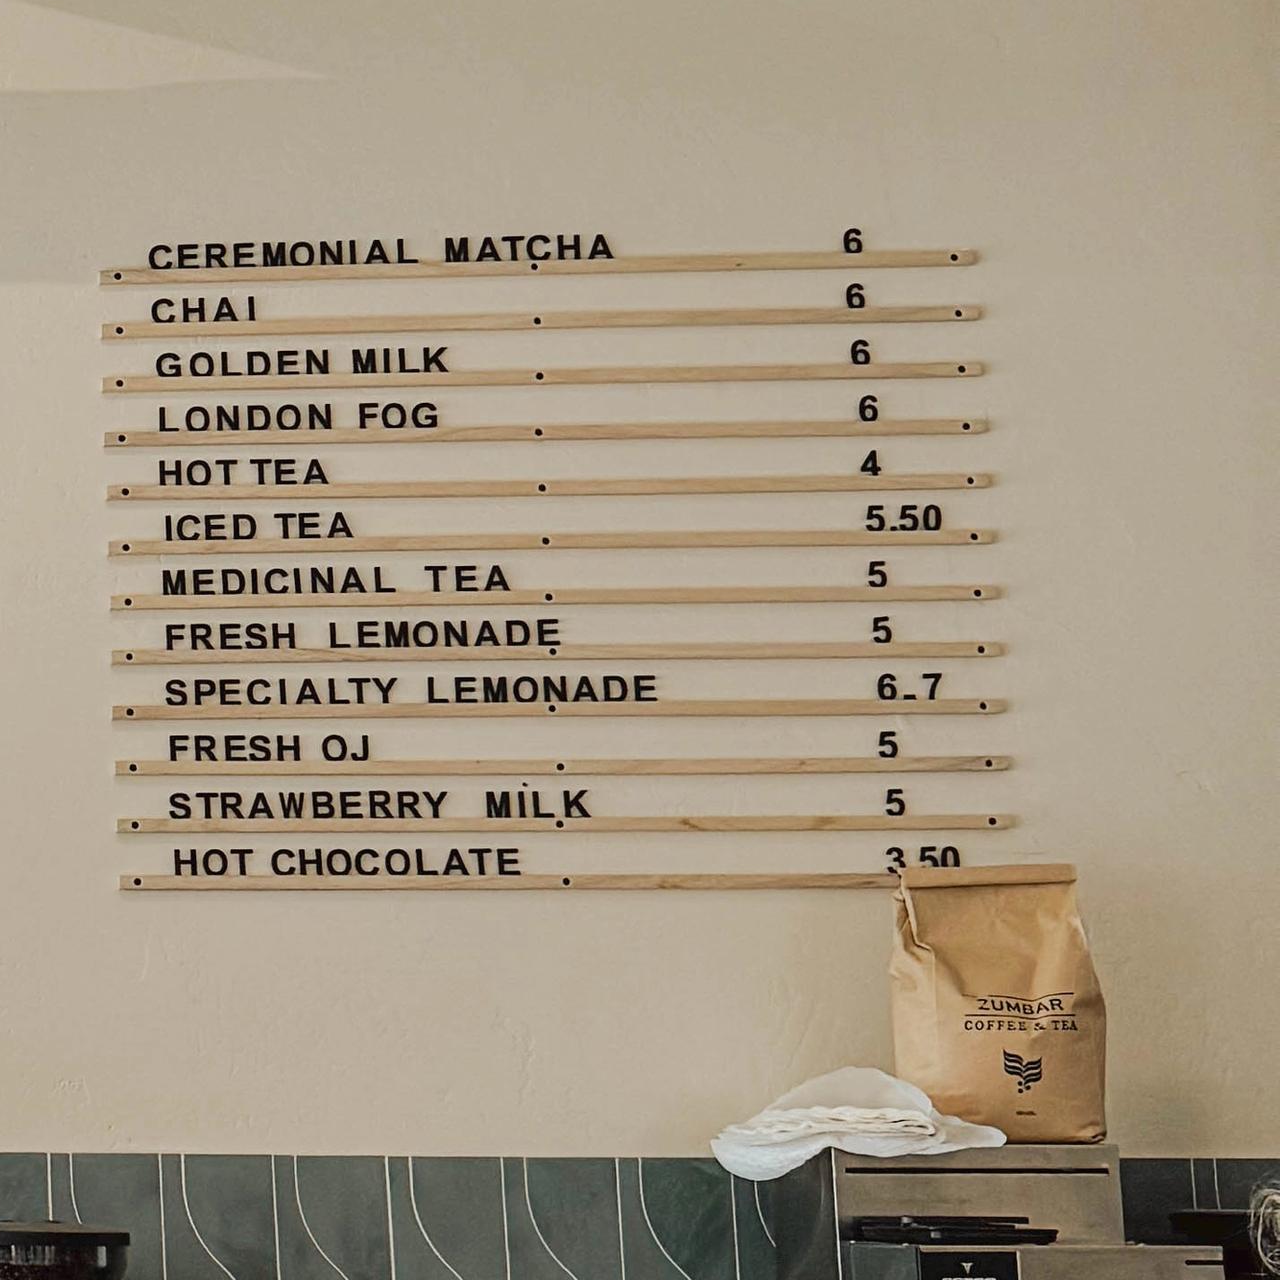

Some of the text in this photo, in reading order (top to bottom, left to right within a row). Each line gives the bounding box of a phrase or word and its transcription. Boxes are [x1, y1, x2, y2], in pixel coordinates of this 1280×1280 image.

[148, 228, 863, 270] CEREMONIAL MATCHA 6
[151, 283, 866, 324] CHAI 6
[155, 339, 871, 378] GOLDEN MILK 6
[158, 394, 879, 432] LONDON FOG 6
[158, 449, 882, 486] HOT TEA 4
[165, 504, 943, 542] ICED TEA 5.50
[162, 560, 888, 596] MEDICINAL TEA 5
[165, 615, 893, 651] FRESH LEMONADE 5
[165, 677, 398, 706] SPECIALTY
[427, 675, 659, 704] LEMONADE
[169, 730, 899, 762] FRESH OJ 5
[169, 790, 448, 820] STRAWBERRY
[885, 788, 906, 817] 5
[173, 845, 961, 877] HOT CHOCOLATE 350
[977, 998, 1065, 1015] ZUMBAR
[964, 1020, 1078, 1031] COFFEE & TEA
